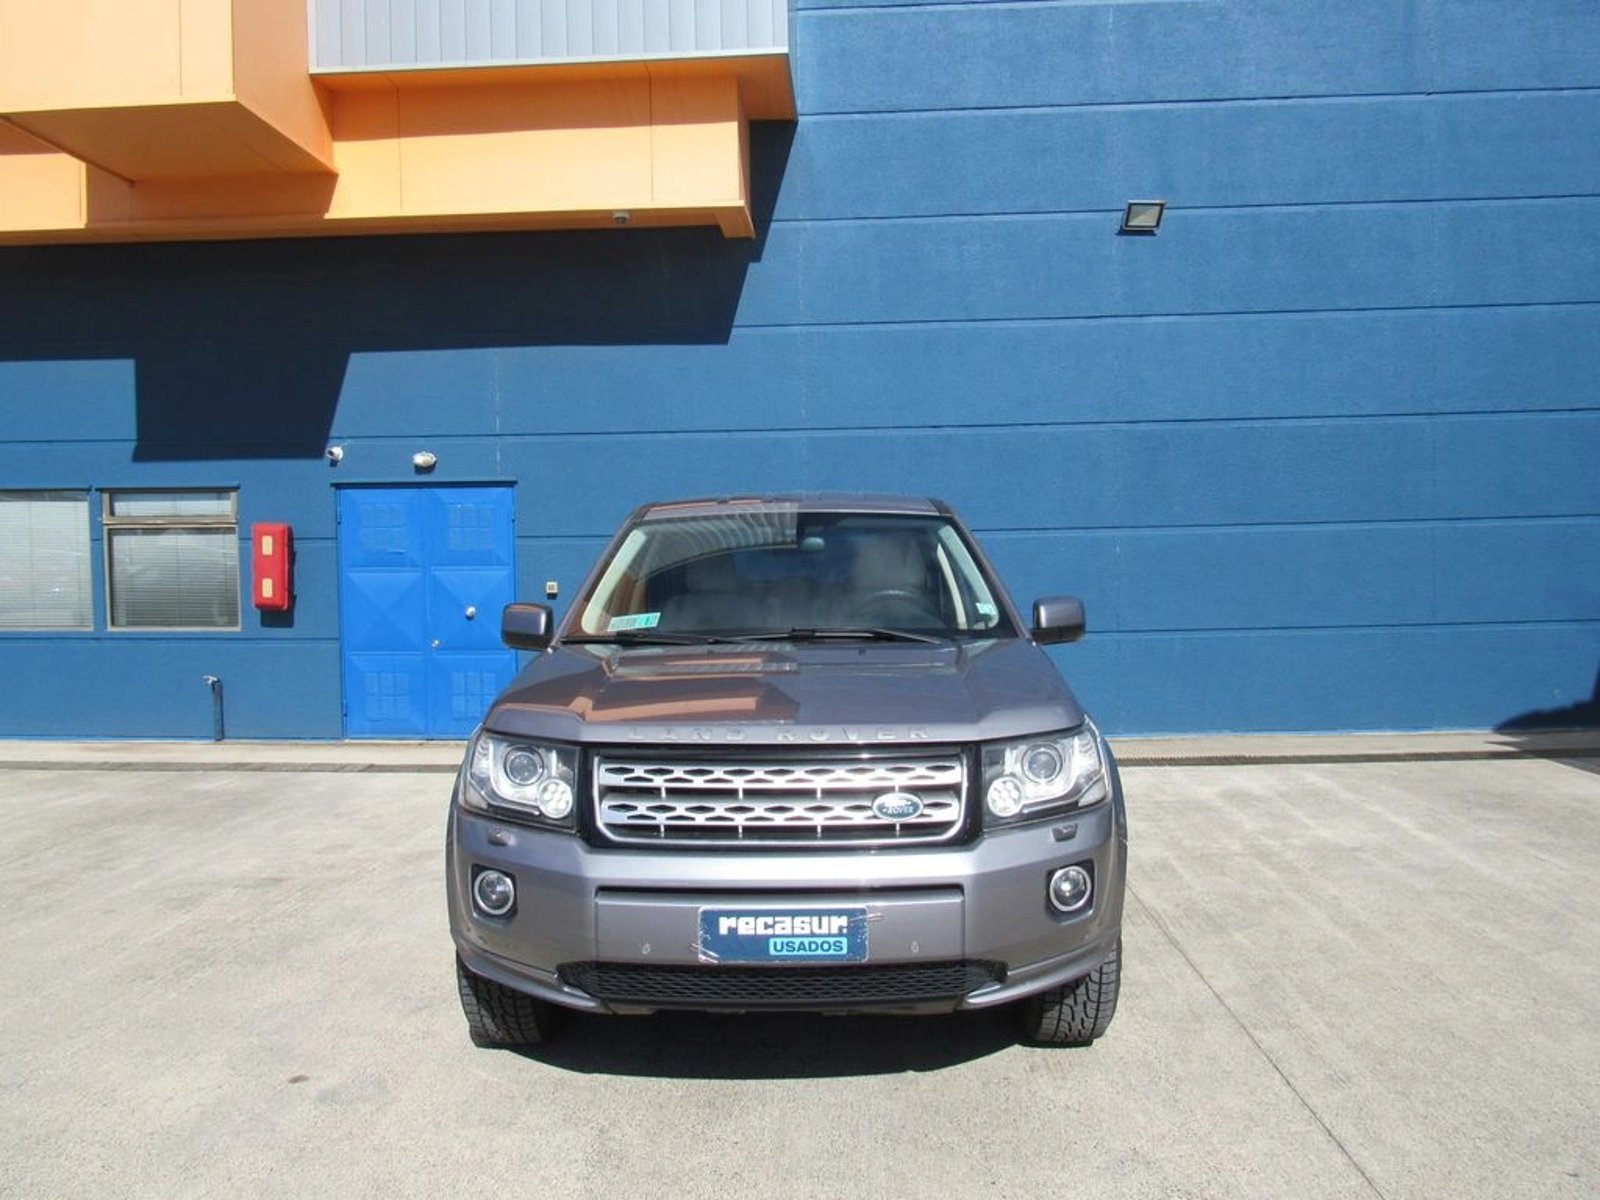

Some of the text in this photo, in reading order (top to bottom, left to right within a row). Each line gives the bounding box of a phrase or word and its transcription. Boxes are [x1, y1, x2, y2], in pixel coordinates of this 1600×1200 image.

[626, 725, 929, 741] LAND ROVER
[772, 940, 844, 953] USADOS
